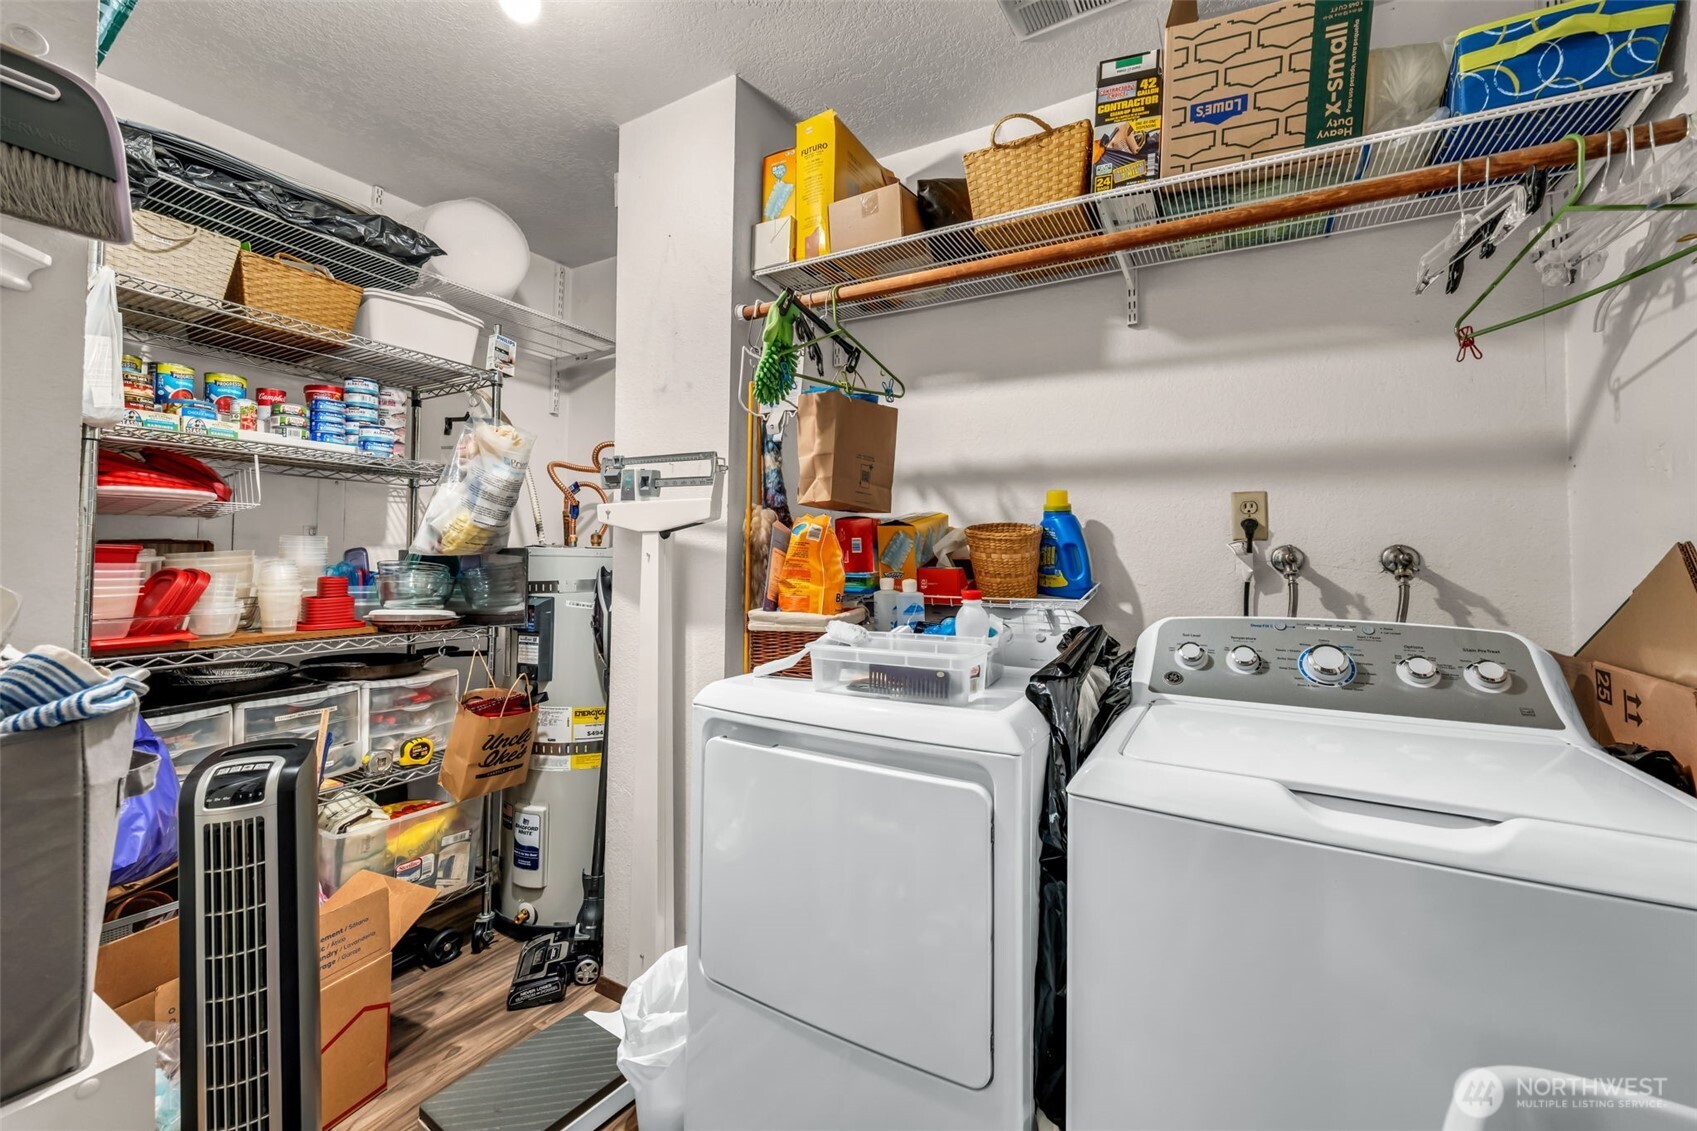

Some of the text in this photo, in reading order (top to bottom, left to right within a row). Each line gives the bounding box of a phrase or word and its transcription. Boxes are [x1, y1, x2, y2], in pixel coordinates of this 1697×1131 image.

[1324, 21, 1349, 117] x-small
[1139, 77, 1157, 89] 42
[1137, 87, 1159, 96] GALLON
[1097, 95, 1159, 114] CONTRACTOR
[1195, 98, 1242, 118] LOWE'S
[1326, 116, 1354, 128] Duty
[1316, 127, 1353, 140] Heavy
[800, 142, 828, 156] FUTURO
[1096, 177, 1111, 187] 24
[496, 335, 516, 347] PHILIPS
[1596, 671, 1610, 701] 25
[482, 728, 532, 751] Uncle
[478, 743, 528, 767] Ike's
